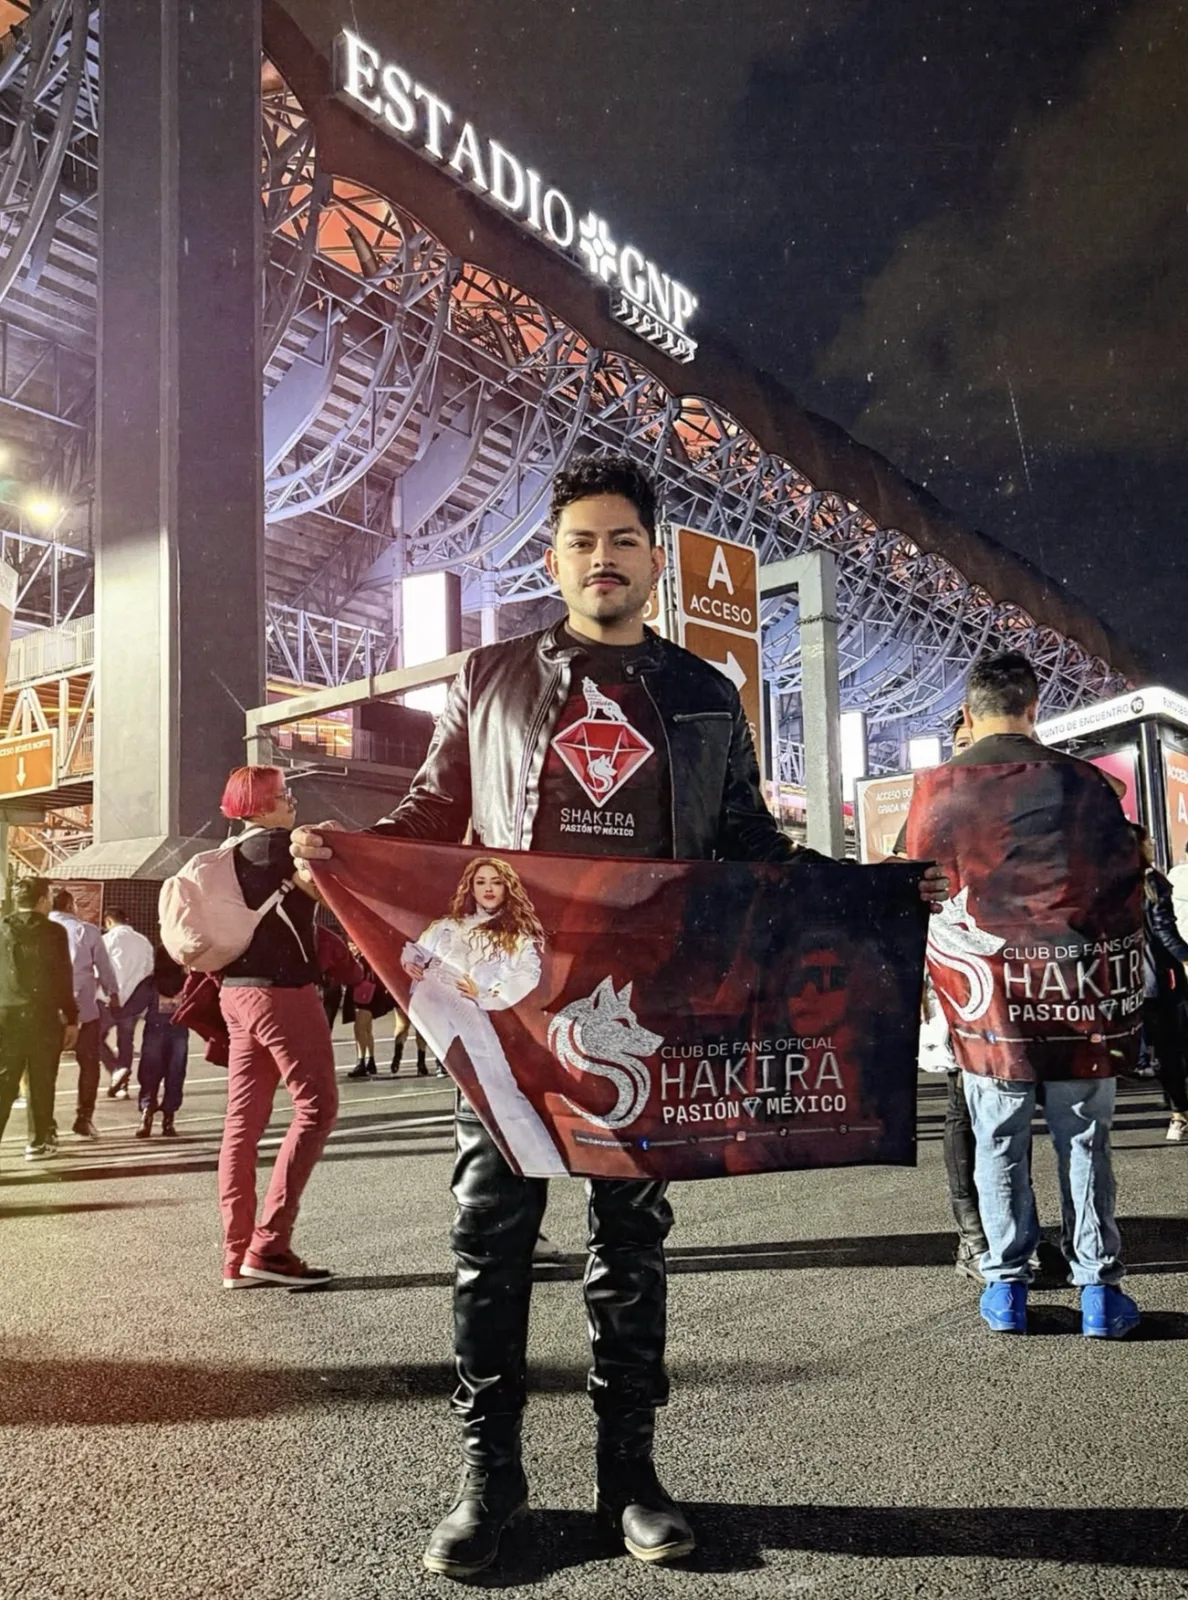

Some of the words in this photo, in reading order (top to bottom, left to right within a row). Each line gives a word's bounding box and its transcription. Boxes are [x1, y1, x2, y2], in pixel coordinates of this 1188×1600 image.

[343, 29, 574, 248] ESTADIO
[620, 247, 694, 332] GNP
[708, 545, 734, 595] A
[690, 594, 752, 625] ACCESO
[1040, 725, 1065, 738] PUNTO
[1067, 721, 1077, 731] DE
[1080, 705, 1129, 726] ENCUENTRO
[876, 790, 901, 801] ACCESO
[560, 807, 635, 827] SHAKIRA
[560, 823, 593, 833] PASIÓN
[1003, 947, 1049, 960] CLUB
[1055, 946, 1078, 959] DE
[1083, 939, 1121, 956] FANS
[1009, 1001, 1095, 1022] PASIÓN
[661, 1046, 703, 1059] CLUB
[708, 1043, 728, 1055] DE
[733, 1040, 771, 1054] FANS
[775, 1036, 836, 1050] OFICIAL
[663, 1097, 739, 1124] PASIÓN
[767, 1093, 847, 1115] MÉXICO
